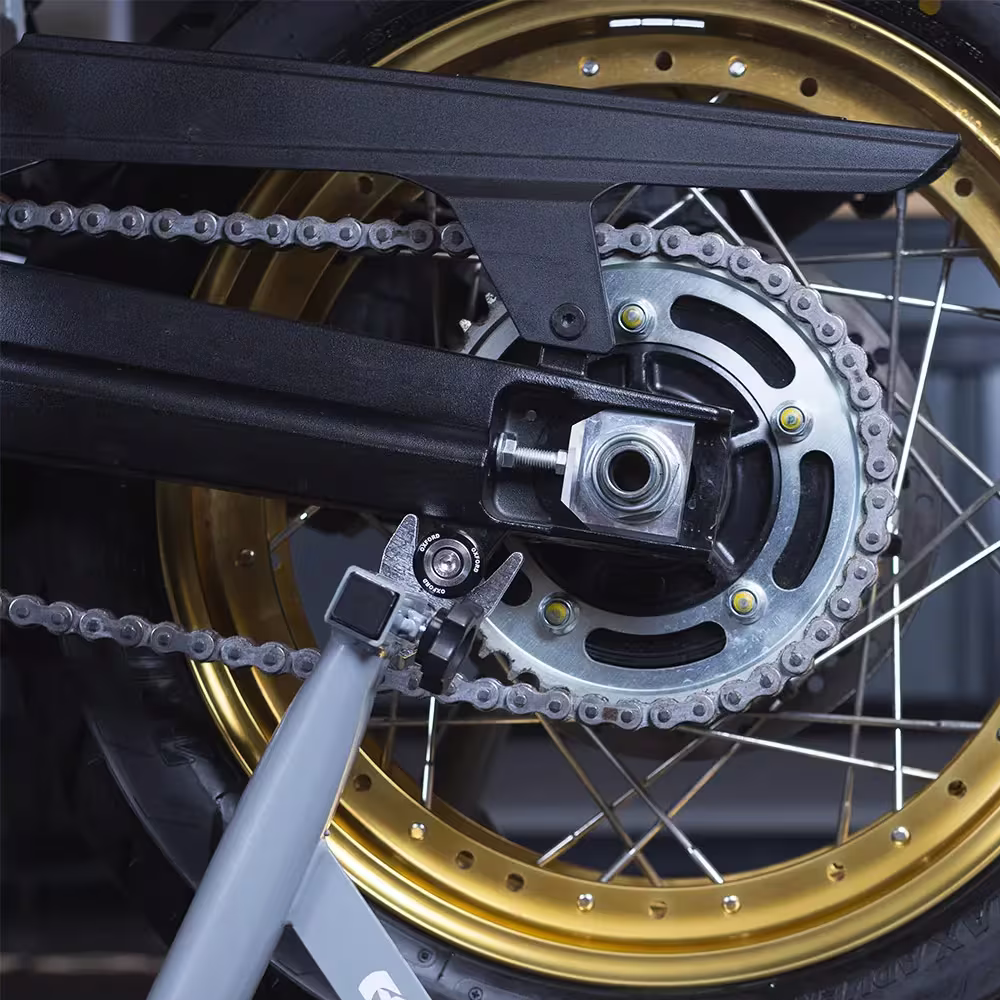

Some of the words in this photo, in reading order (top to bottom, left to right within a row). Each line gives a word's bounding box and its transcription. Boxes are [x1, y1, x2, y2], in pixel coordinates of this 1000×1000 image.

[420, 533, 441, 552] OXFORD
[471, 547, 481, 573] OXFORD
[422, 578, 446, 595] OXFORD
